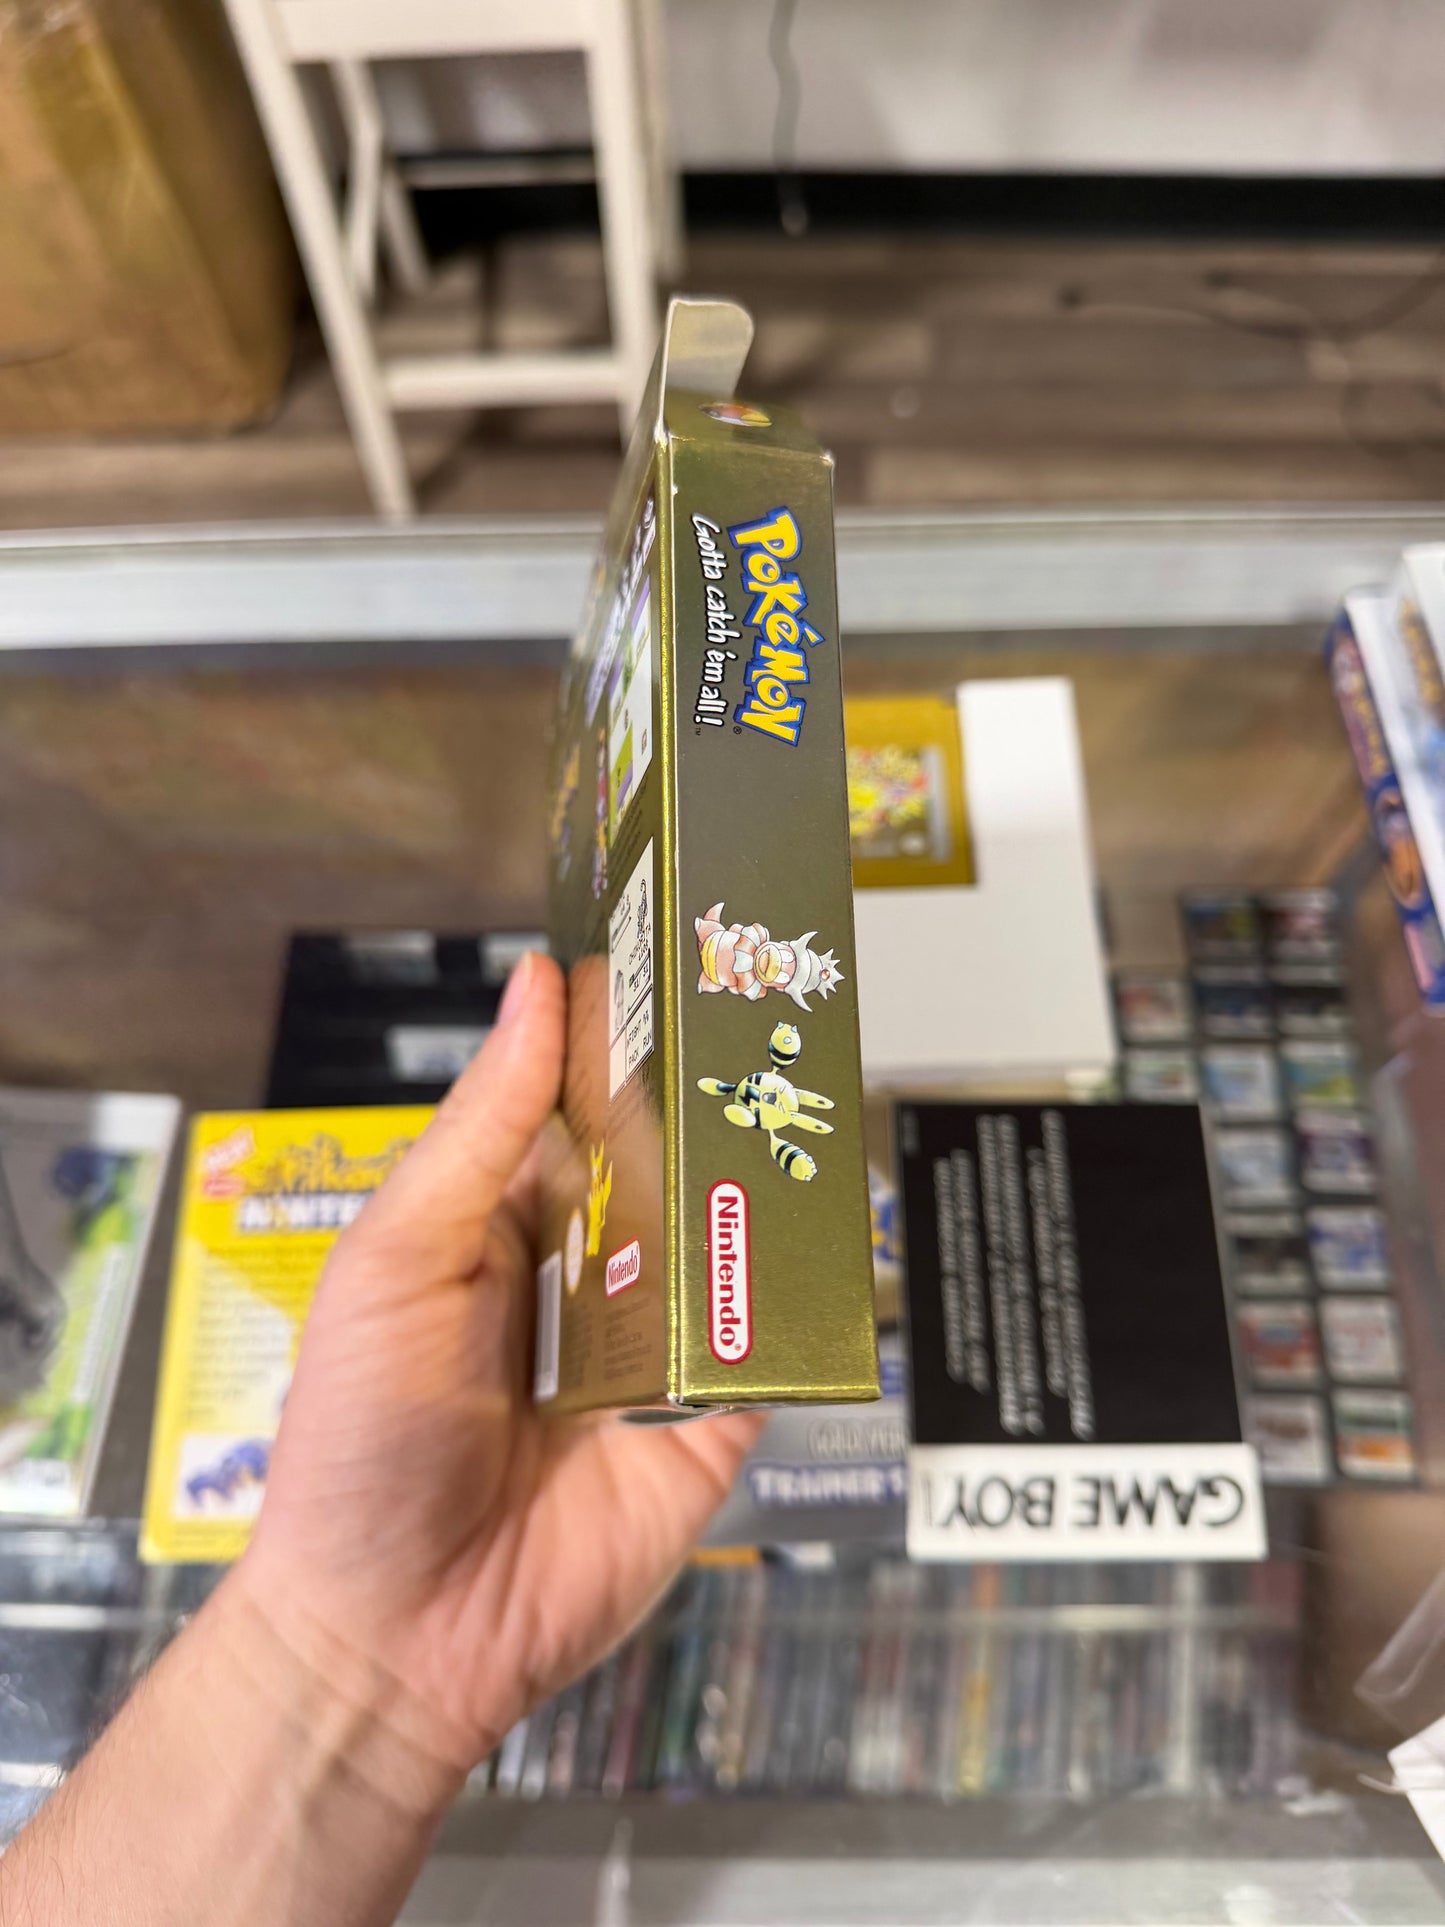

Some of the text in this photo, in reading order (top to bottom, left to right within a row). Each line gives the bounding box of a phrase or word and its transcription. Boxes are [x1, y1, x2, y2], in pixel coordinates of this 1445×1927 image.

[691, 512, 729, 581] Gotta
[704, 583, 742, 646] catch
[695, 685, 728, 728] all!
[608, 1249, 639, 1287] Nintendo
[717, 1195, 742, 1347] Nintendo
[938, 1474, 1245, 1534] GAME BOY
